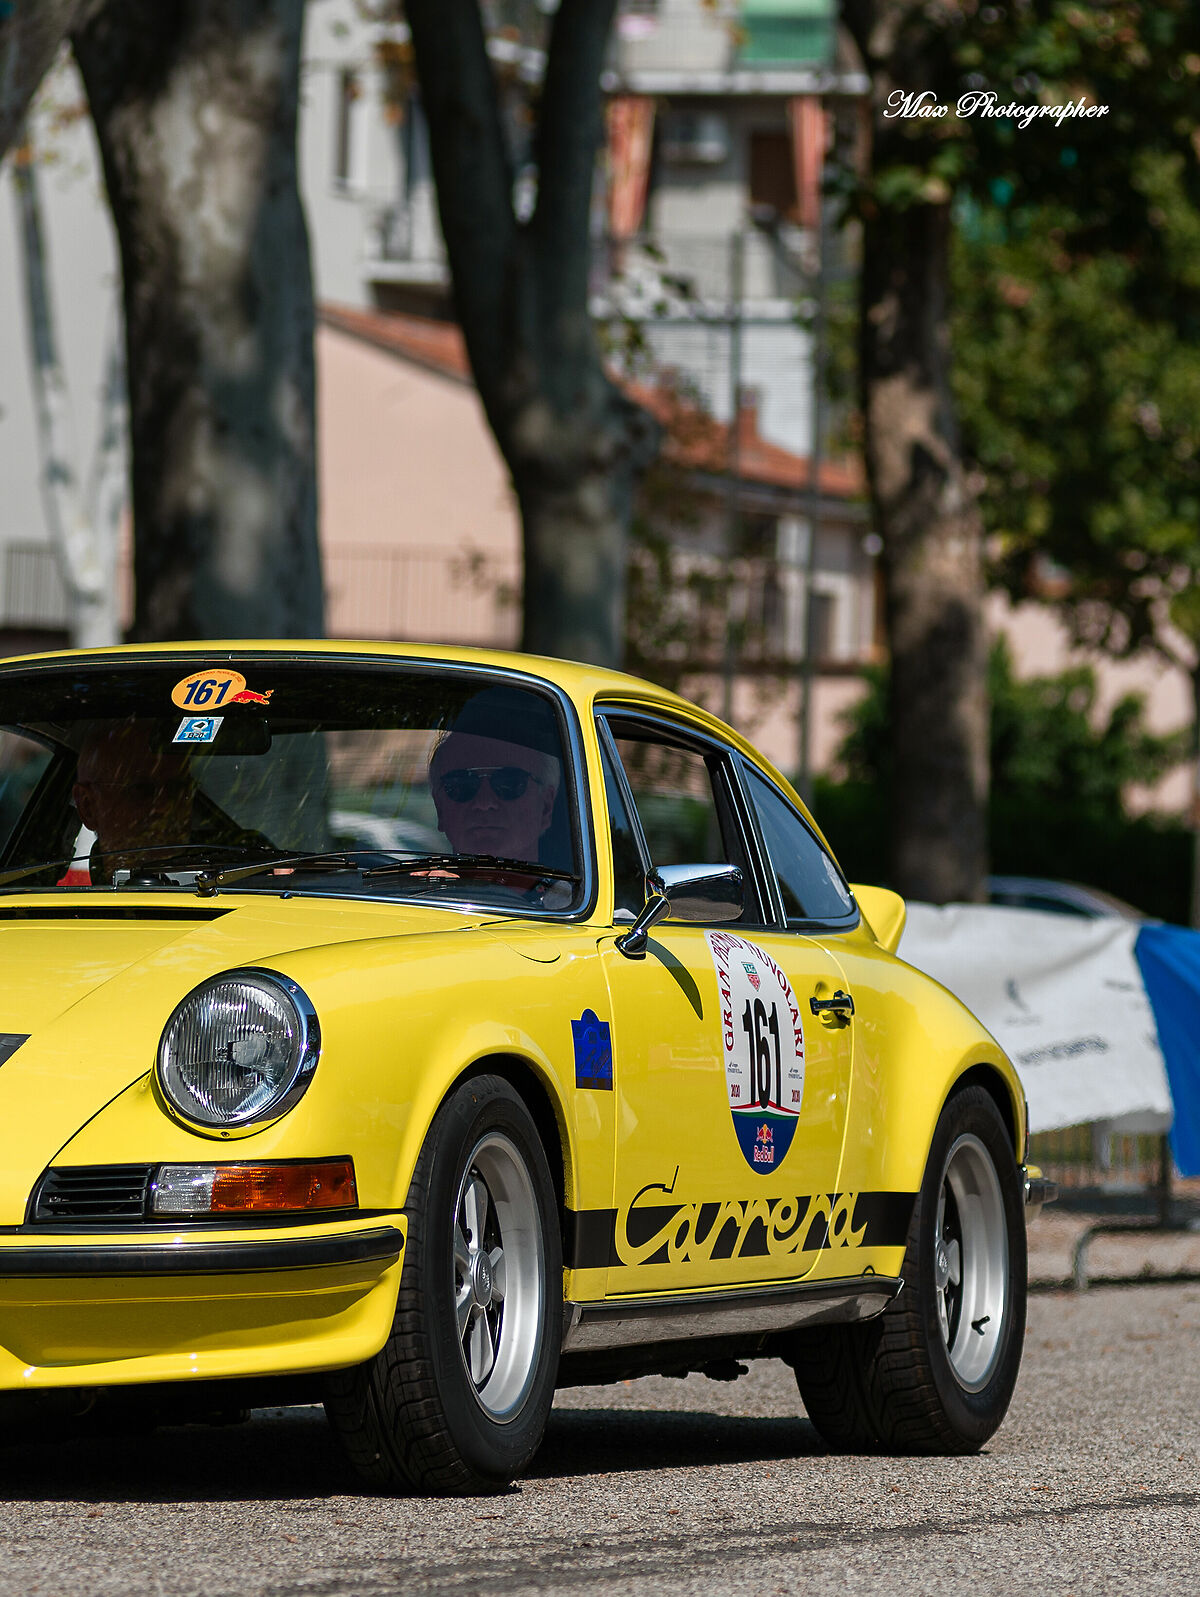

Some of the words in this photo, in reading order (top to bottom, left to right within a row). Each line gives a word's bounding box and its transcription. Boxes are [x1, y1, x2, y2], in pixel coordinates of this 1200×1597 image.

[183, 679, 233, 705] 161
[717, 964, 735, 1052] GRAN
[741, 998, 782, 1109] 161
[614, 1165, 869, 1267] Carrera
